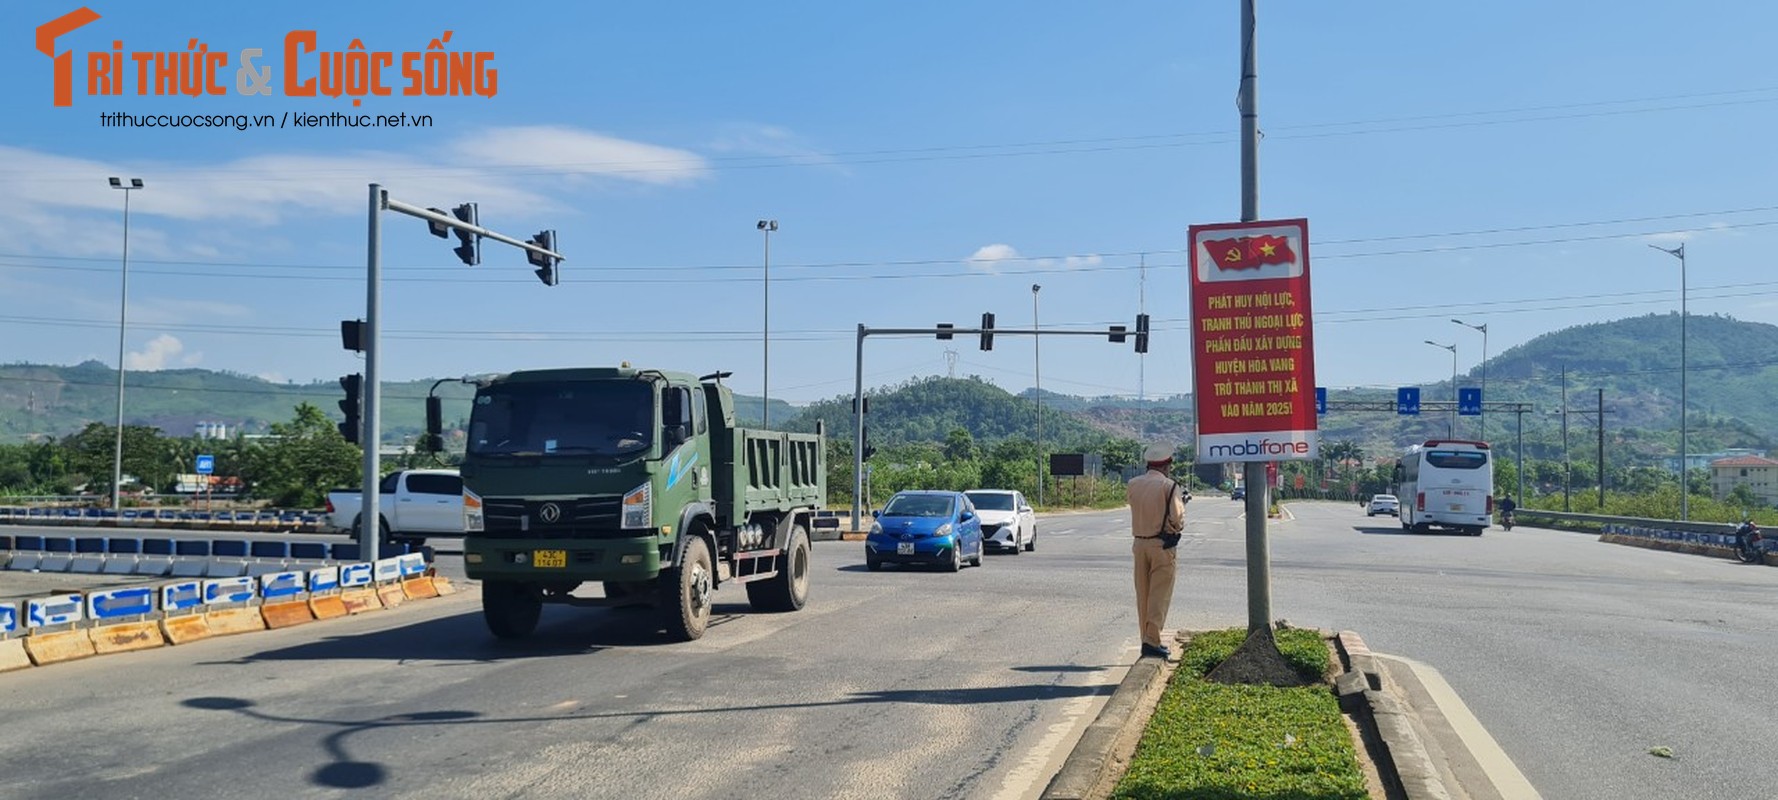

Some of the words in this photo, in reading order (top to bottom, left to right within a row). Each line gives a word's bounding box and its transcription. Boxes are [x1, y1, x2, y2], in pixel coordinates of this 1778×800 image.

[1208, 293, 1232, 310] PHÁT
[1235, 294, 1253, 308] HUY
[1255, 291, 1272, 309] NỘI
[1274, 290, 1295, 309] LỰC,
[1202, 317, 1232, 331] TRANH
[1235, 312, 1252, 330] THỦ
[1254, 314, 1283, 330] NGOẠI
[1286, 312, 1304, 330] LỰC
[1206, 335, 1231, 353] PHẤN
[1255, 335, 1273, 351] XÂY
[1276, 335, 1302, 352] DỰNG
[1215, 358, 1246, 376] HUYỆN
[1248, 356, 1267, 374] HÒA
[1270, 358, 1295, 372] VANG
[1214, 378, 1232, 396] TRỞ
[1234, 379, 1265, 396] THÀNH
[1267, 379, 1283, 396] THỊ
[1285, 377, 1298, 393] XÃ
[1221, 402, 1240, 418] VÀO
[1242, 400, 1264, 417] NĂM
[1266, 401, 1293, 416] 2025!
[1209, 438, 1309, 457] mobifone
